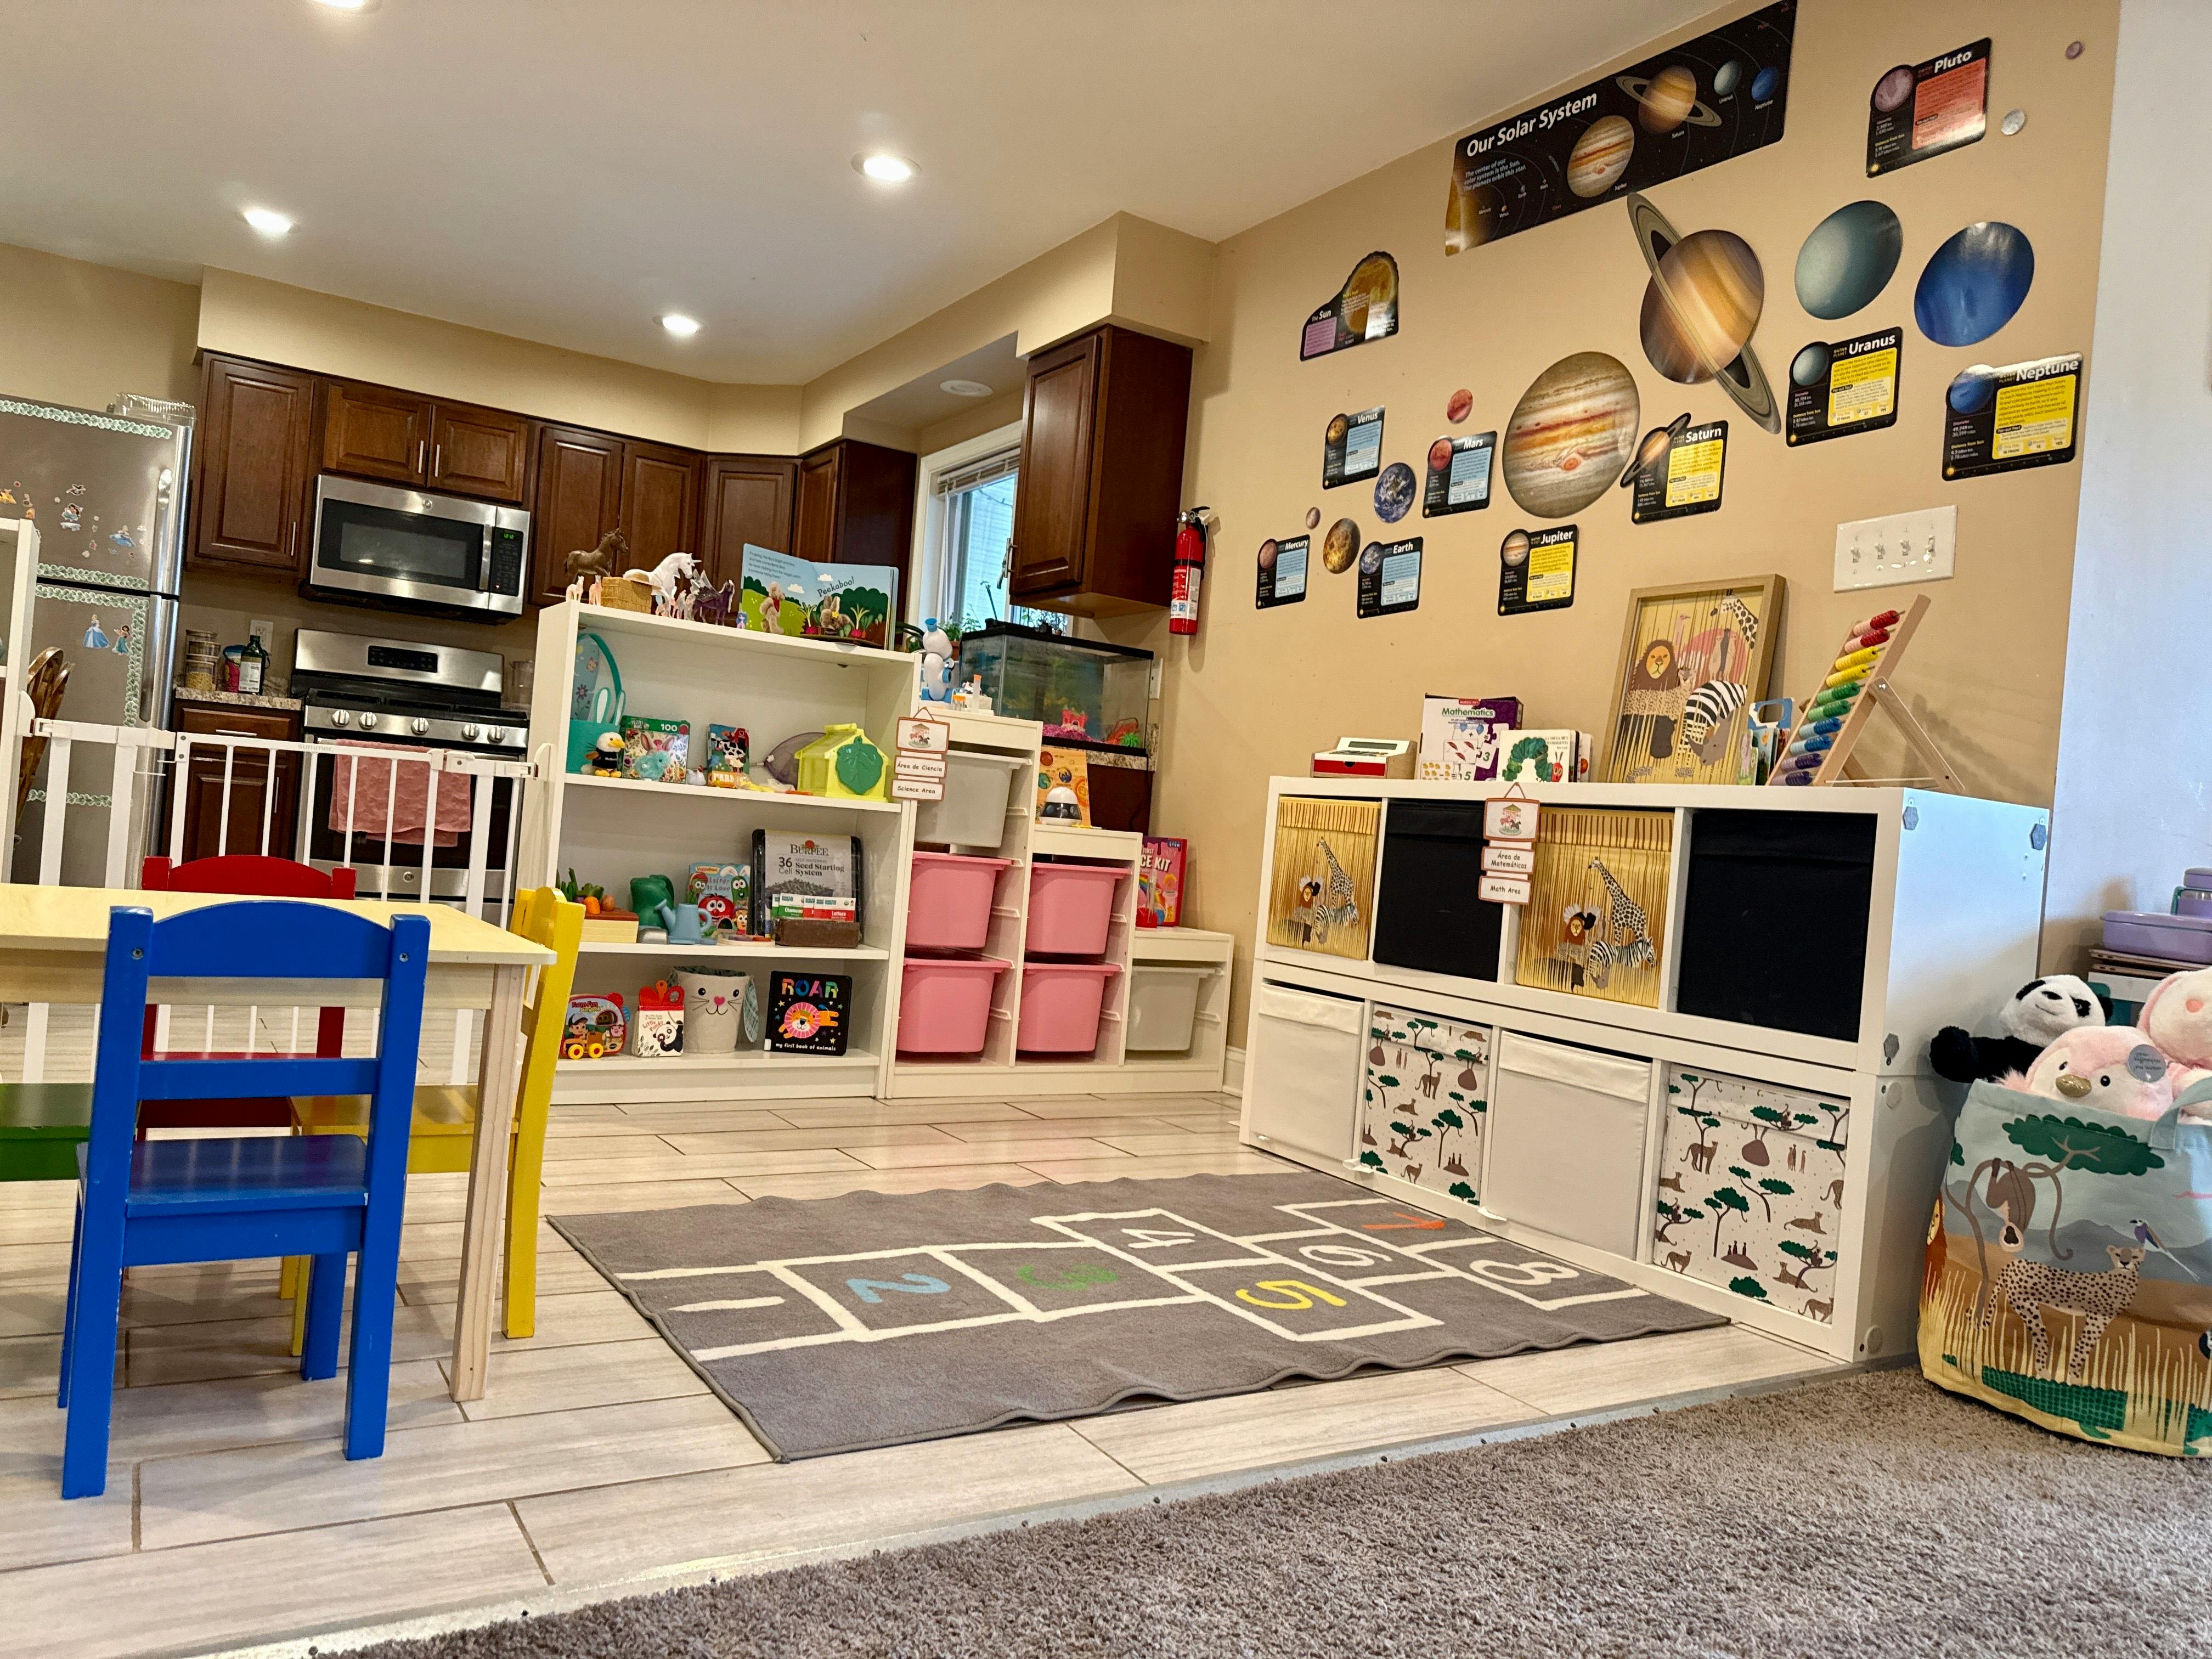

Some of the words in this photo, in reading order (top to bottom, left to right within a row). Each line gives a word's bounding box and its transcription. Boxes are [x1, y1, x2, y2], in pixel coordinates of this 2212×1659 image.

[1934, 51, 1972, 73] Pluto
[1467, 136, 1494, 157] Our
[1497, 118, 1536, 146] Solar
[1538, 93, 1597, 129] System
[1319, 309, 1331, 320] Sun
[1849, 335, 1895, 355] Uranus
[2016, 360, 2079, 382] Neptune
[1357, 412, 1378, 424] Venus
[1685, 427, 1722, 443] Saturn
[1463, 438, 1483, 450] Mars
[1541, 531, 1573, 545] Jupiter
[1285, 540, 1308, 550] Mercury
[1393, 541, 1413, 554] Earth
[817, 576, 854, 597] Peekaboo!
[1442, 707, 1494, 718] Mathematics
[661, 724, 678, 732] 100
[1482, 752, 1491, 761] 3
[790, 844, 829, 856] BURPEE
[1497, 851, 1511, 860] Área
[778, 857, 792, 867] 36
[815, 862, 844, 872] Starting
[1154, 856, 1171, 872] KIT
[1491, 860, 1527, 869] Matemáticas
[778, 867, 793, 875] Cell
[782, 978, 838, 998] ROAR
[642, 1020, 656, 1029] Little
[650, 1021, 663, 1031] Panda
[1120, 1228, 1195, 1249] 4
[1298, 1245, 1393, 1266] 6
[1017, 1263, 1119, 1291] 3
[1469, 1259, 1580, 1285] 8
[846, 1272, 952, 1304] 2
[1236, 1280, 1348, 1311] 5
